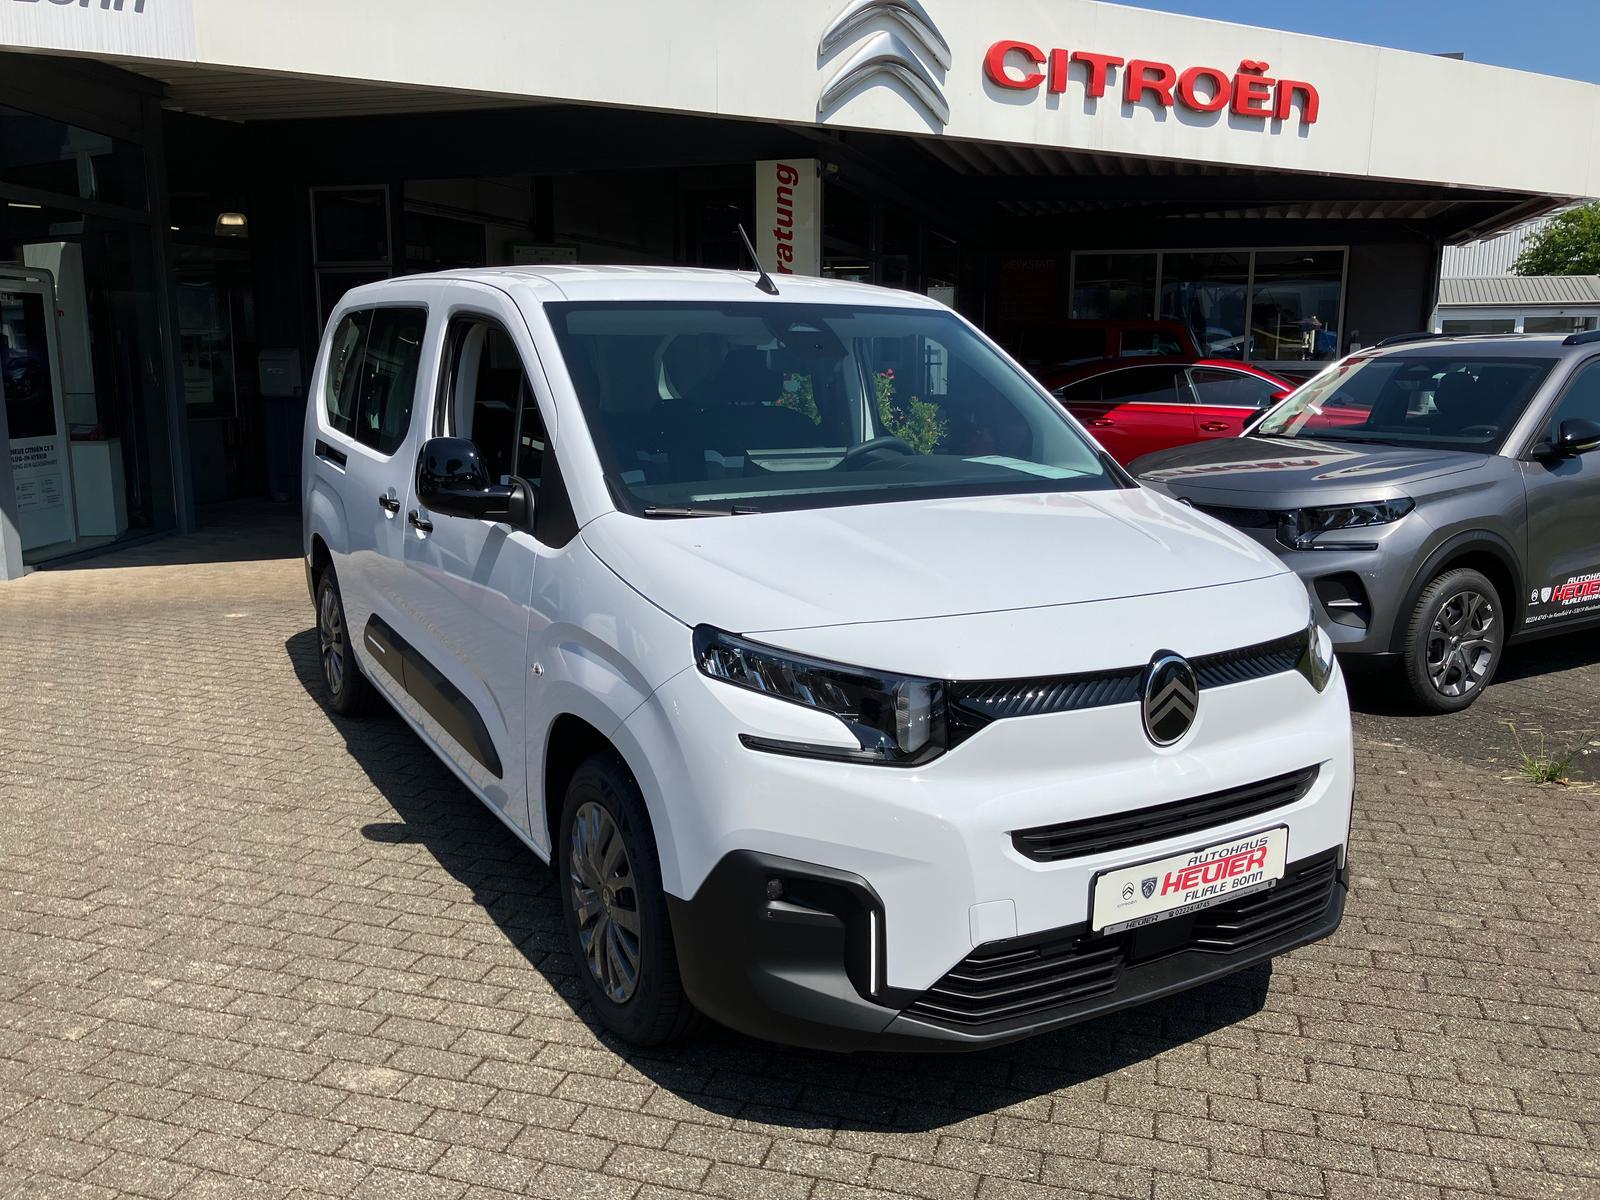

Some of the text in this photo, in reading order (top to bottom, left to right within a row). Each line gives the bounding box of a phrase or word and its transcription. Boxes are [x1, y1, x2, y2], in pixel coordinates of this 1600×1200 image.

[1187, 836, 1269, 866] AUTOHAUS
[1160, 845, 1268, 896] HEUTER
[1184, 881, 1227, 902] FILIALE
[1232, 871, 1264, 889] BONN
[1125, 901, 1211, 929] HEUTER 02224/4745
